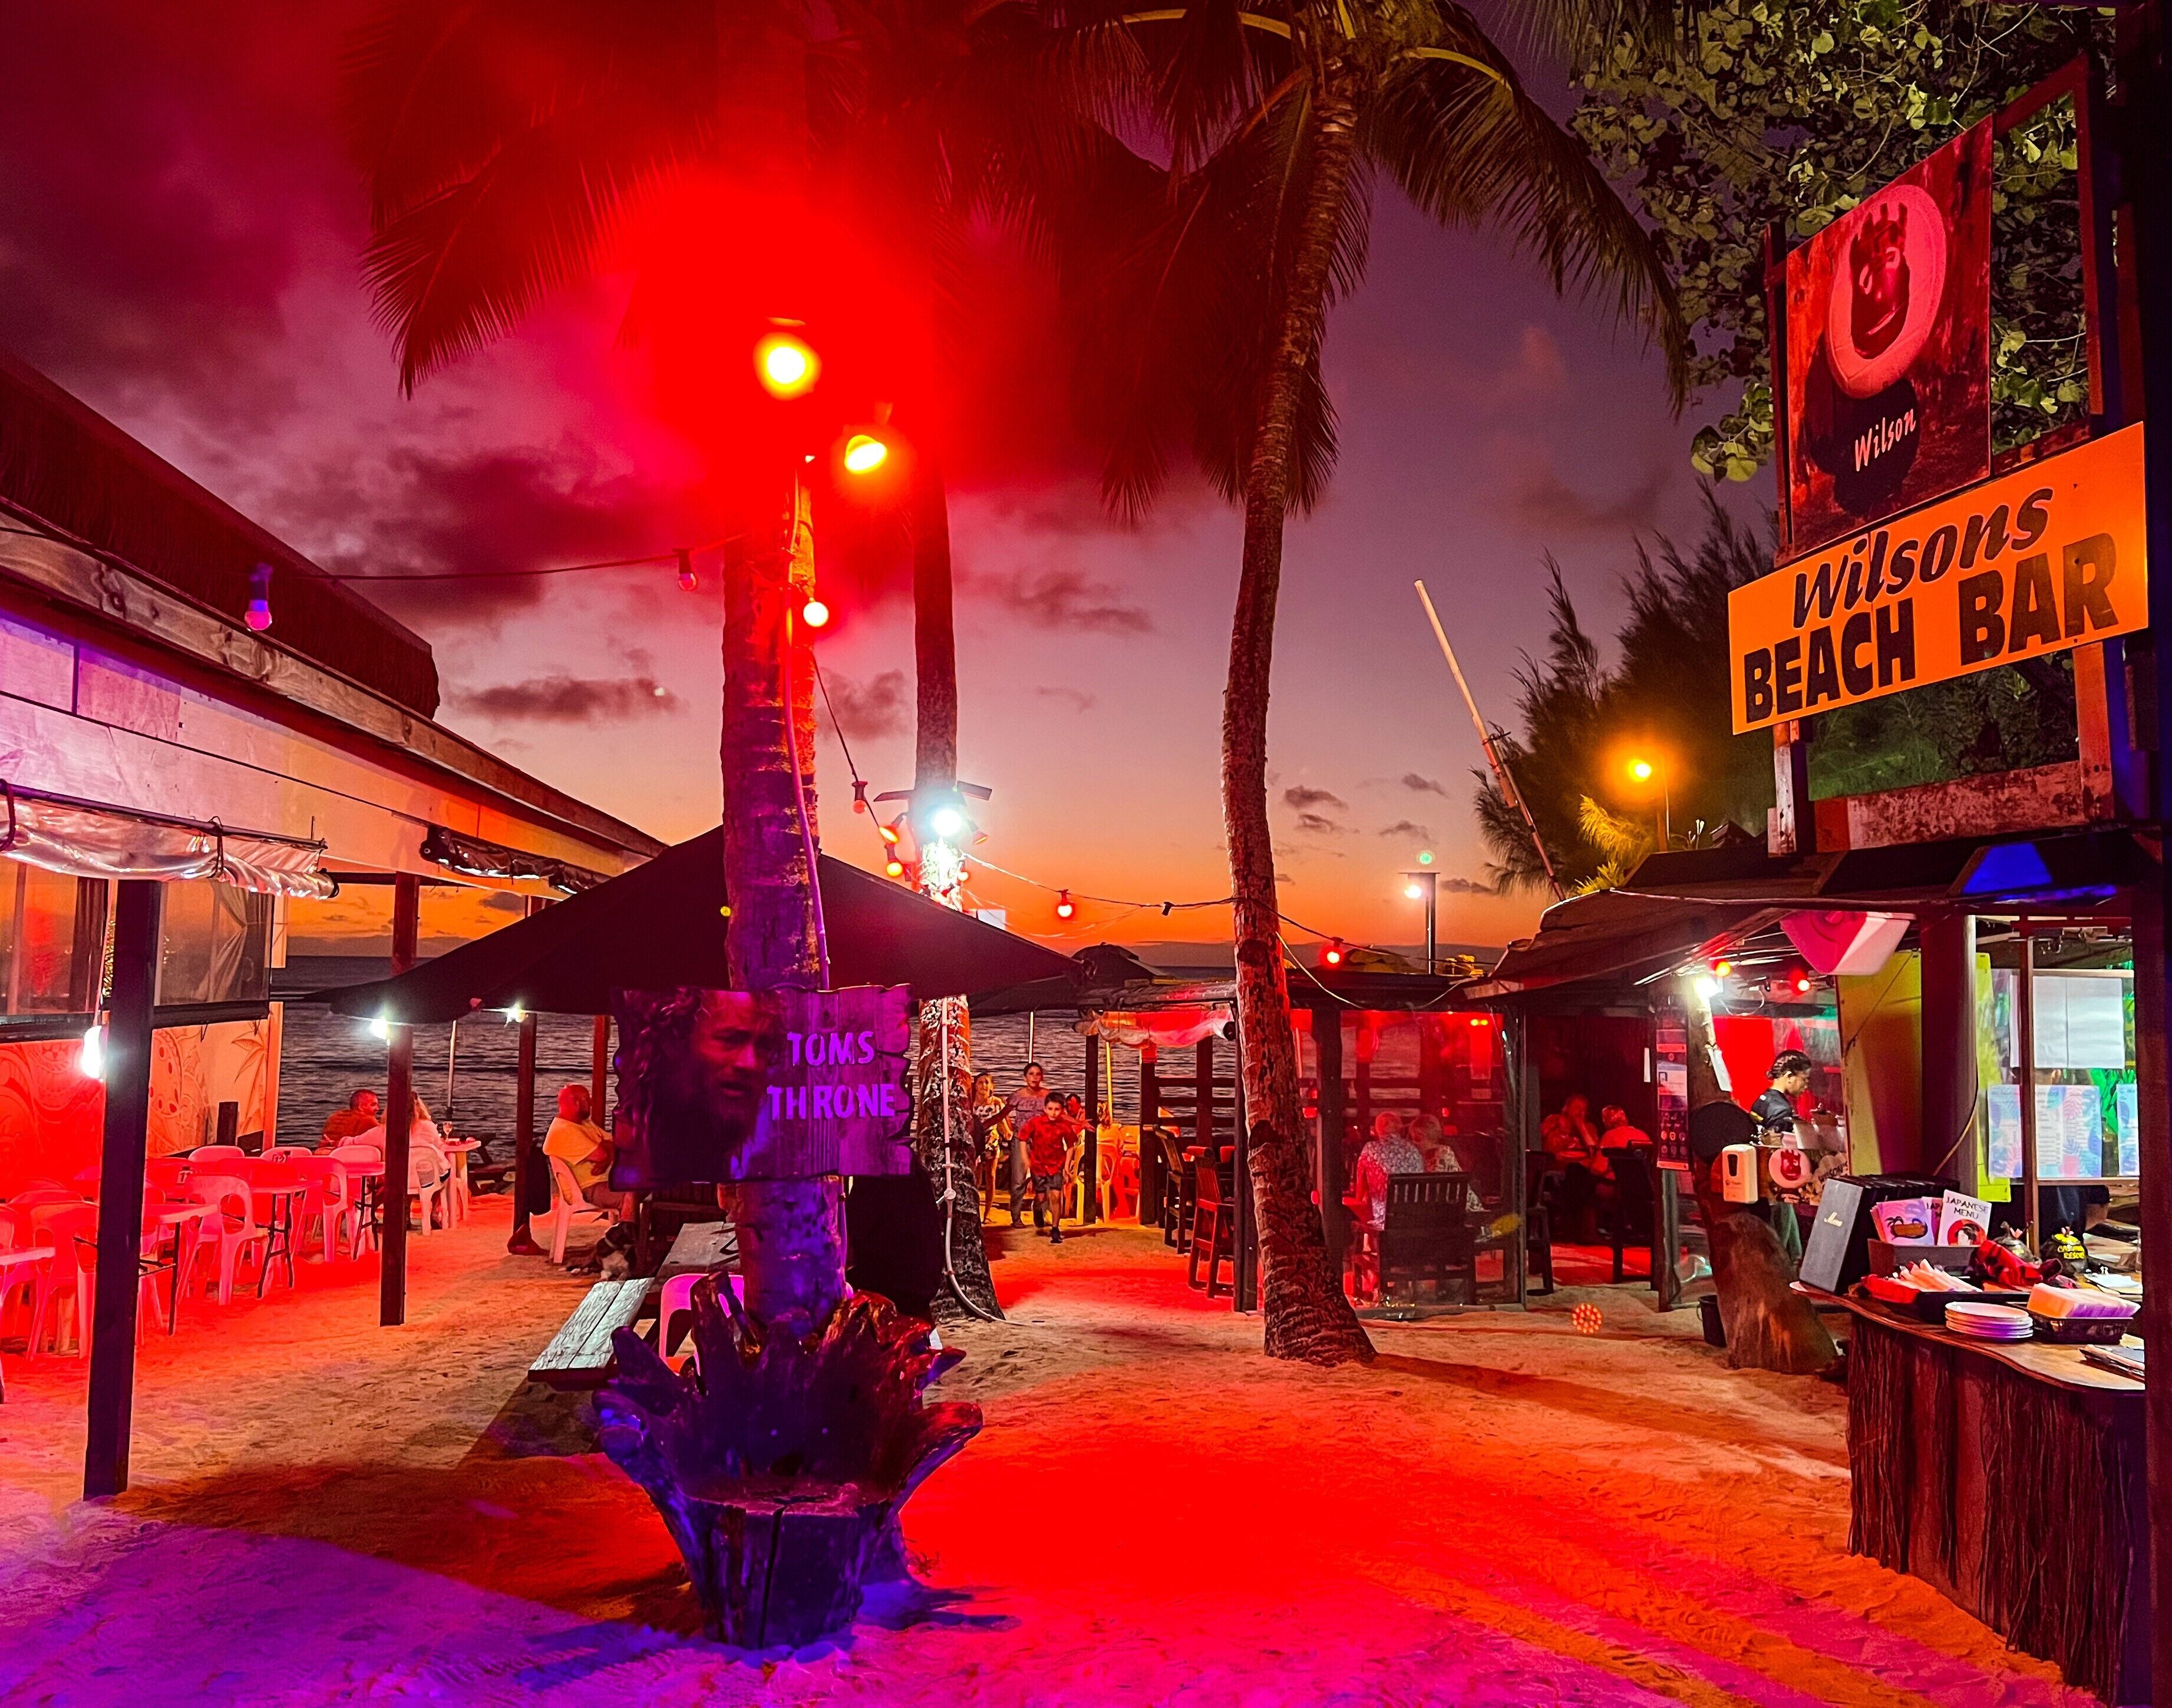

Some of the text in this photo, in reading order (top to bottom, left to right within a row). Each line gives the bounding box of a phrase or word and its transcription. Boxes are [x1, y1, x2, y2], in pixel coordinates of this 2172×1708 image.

[1855, 408, 1916, 472] Wilson
[1793, 488, 2053, 629] Wilsons
[1744, 533, 2120, 725] BEACH BAR
[787, 1031, 875, 1066] TOMS
[767, 1083, 895, 1120] THRONE
[1945, 1197, 1989, 1214] JAPANESE
[1953, 1207, 1979, 1220] MENU
